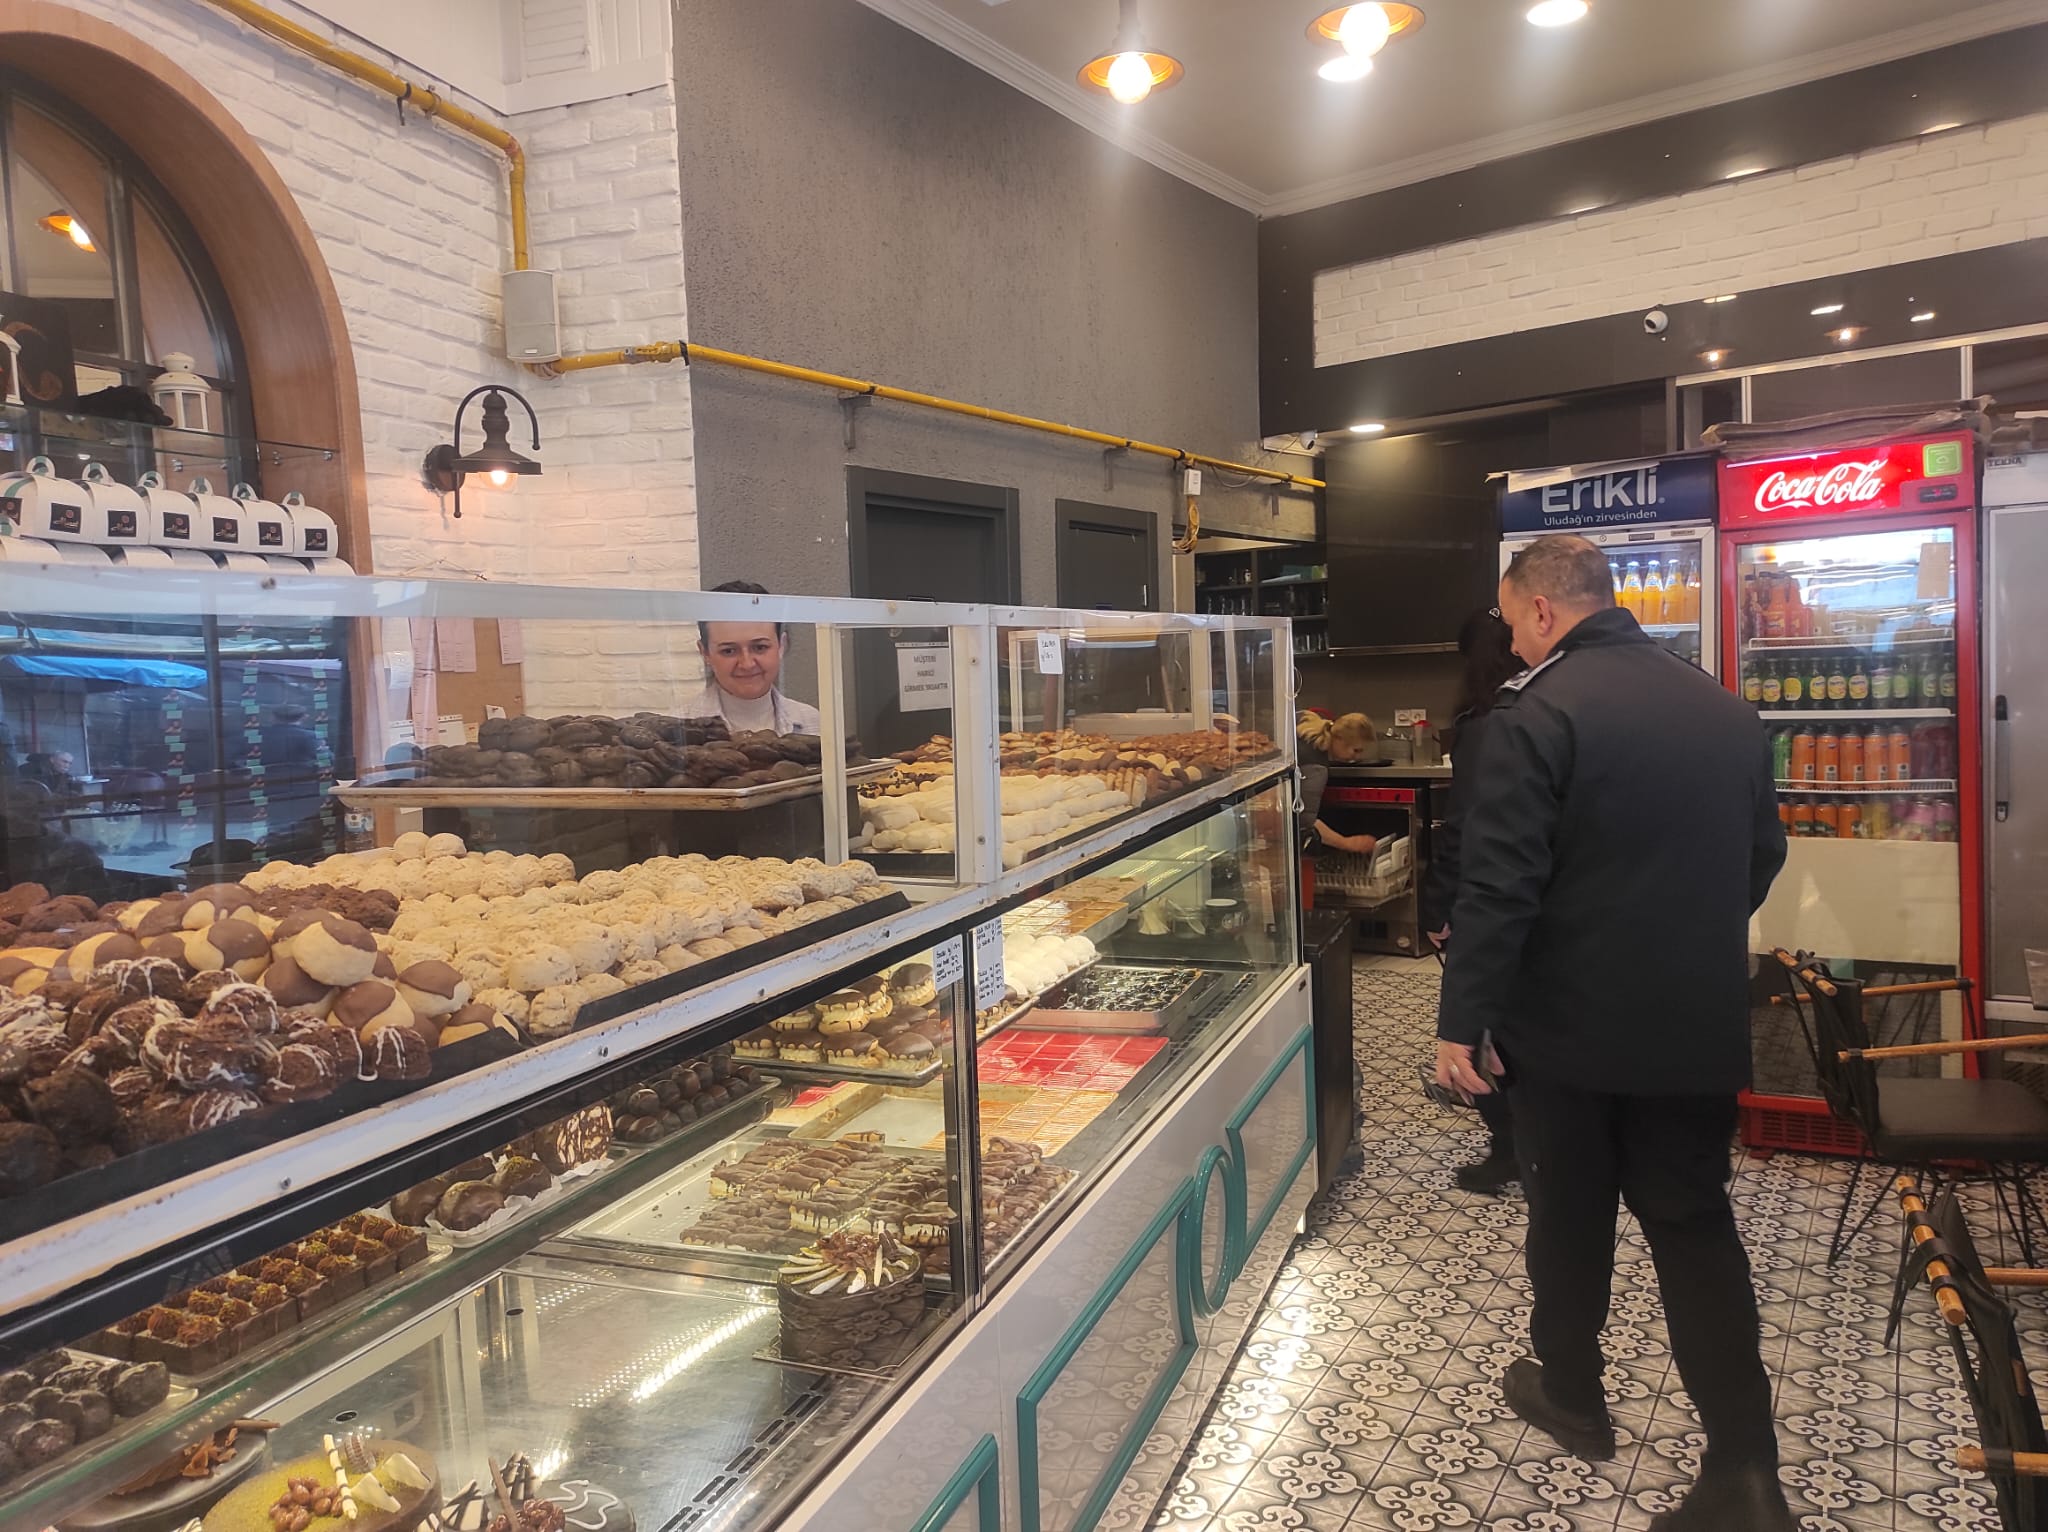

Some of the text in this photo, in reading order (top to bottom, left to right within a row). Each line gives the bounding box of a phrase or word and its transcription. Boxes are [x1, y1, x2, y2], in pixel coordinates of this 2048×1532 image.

[1754, 458, 1888, 513] Coca-Cola
[1543, 509, 1657, 526] Uludağ'ın zirvesinden
